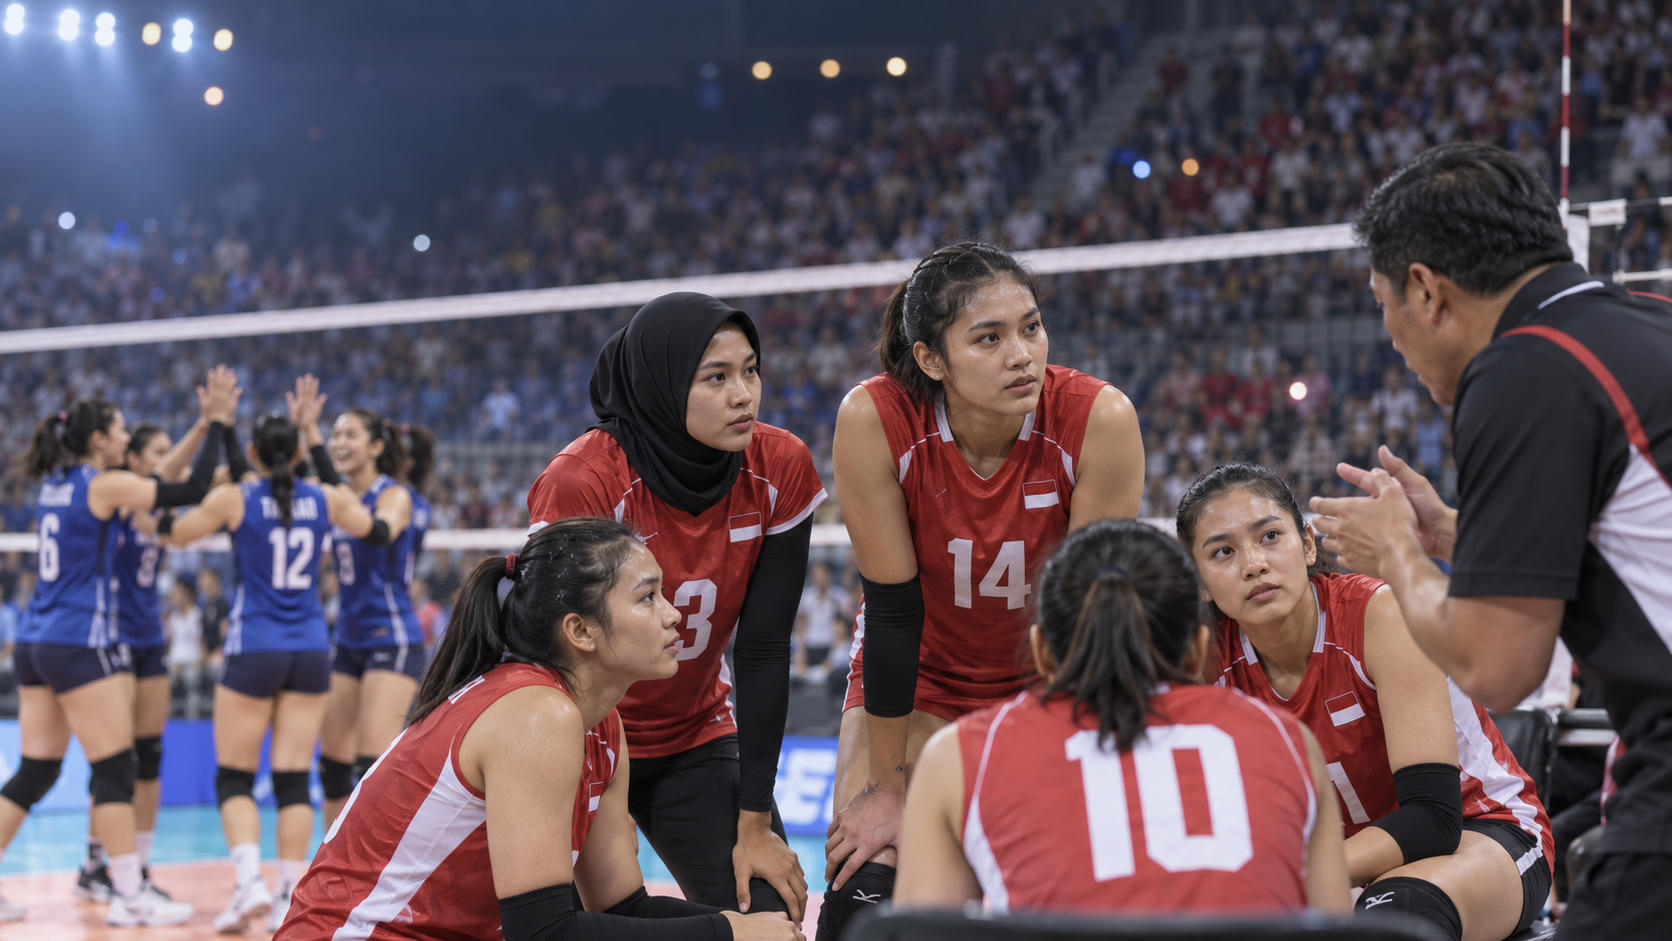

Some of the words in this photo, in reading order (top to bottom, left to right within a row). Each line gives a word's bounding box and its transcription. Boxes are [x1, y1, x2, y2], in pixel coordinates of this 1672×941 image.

[40, 512, 60, 582] 6
[268, 526, 315, 590] 12
[948, 538, 1032, 610] 14
[673, 578, 718, 661] 3
[1064, 723, 1254, 882] 10
